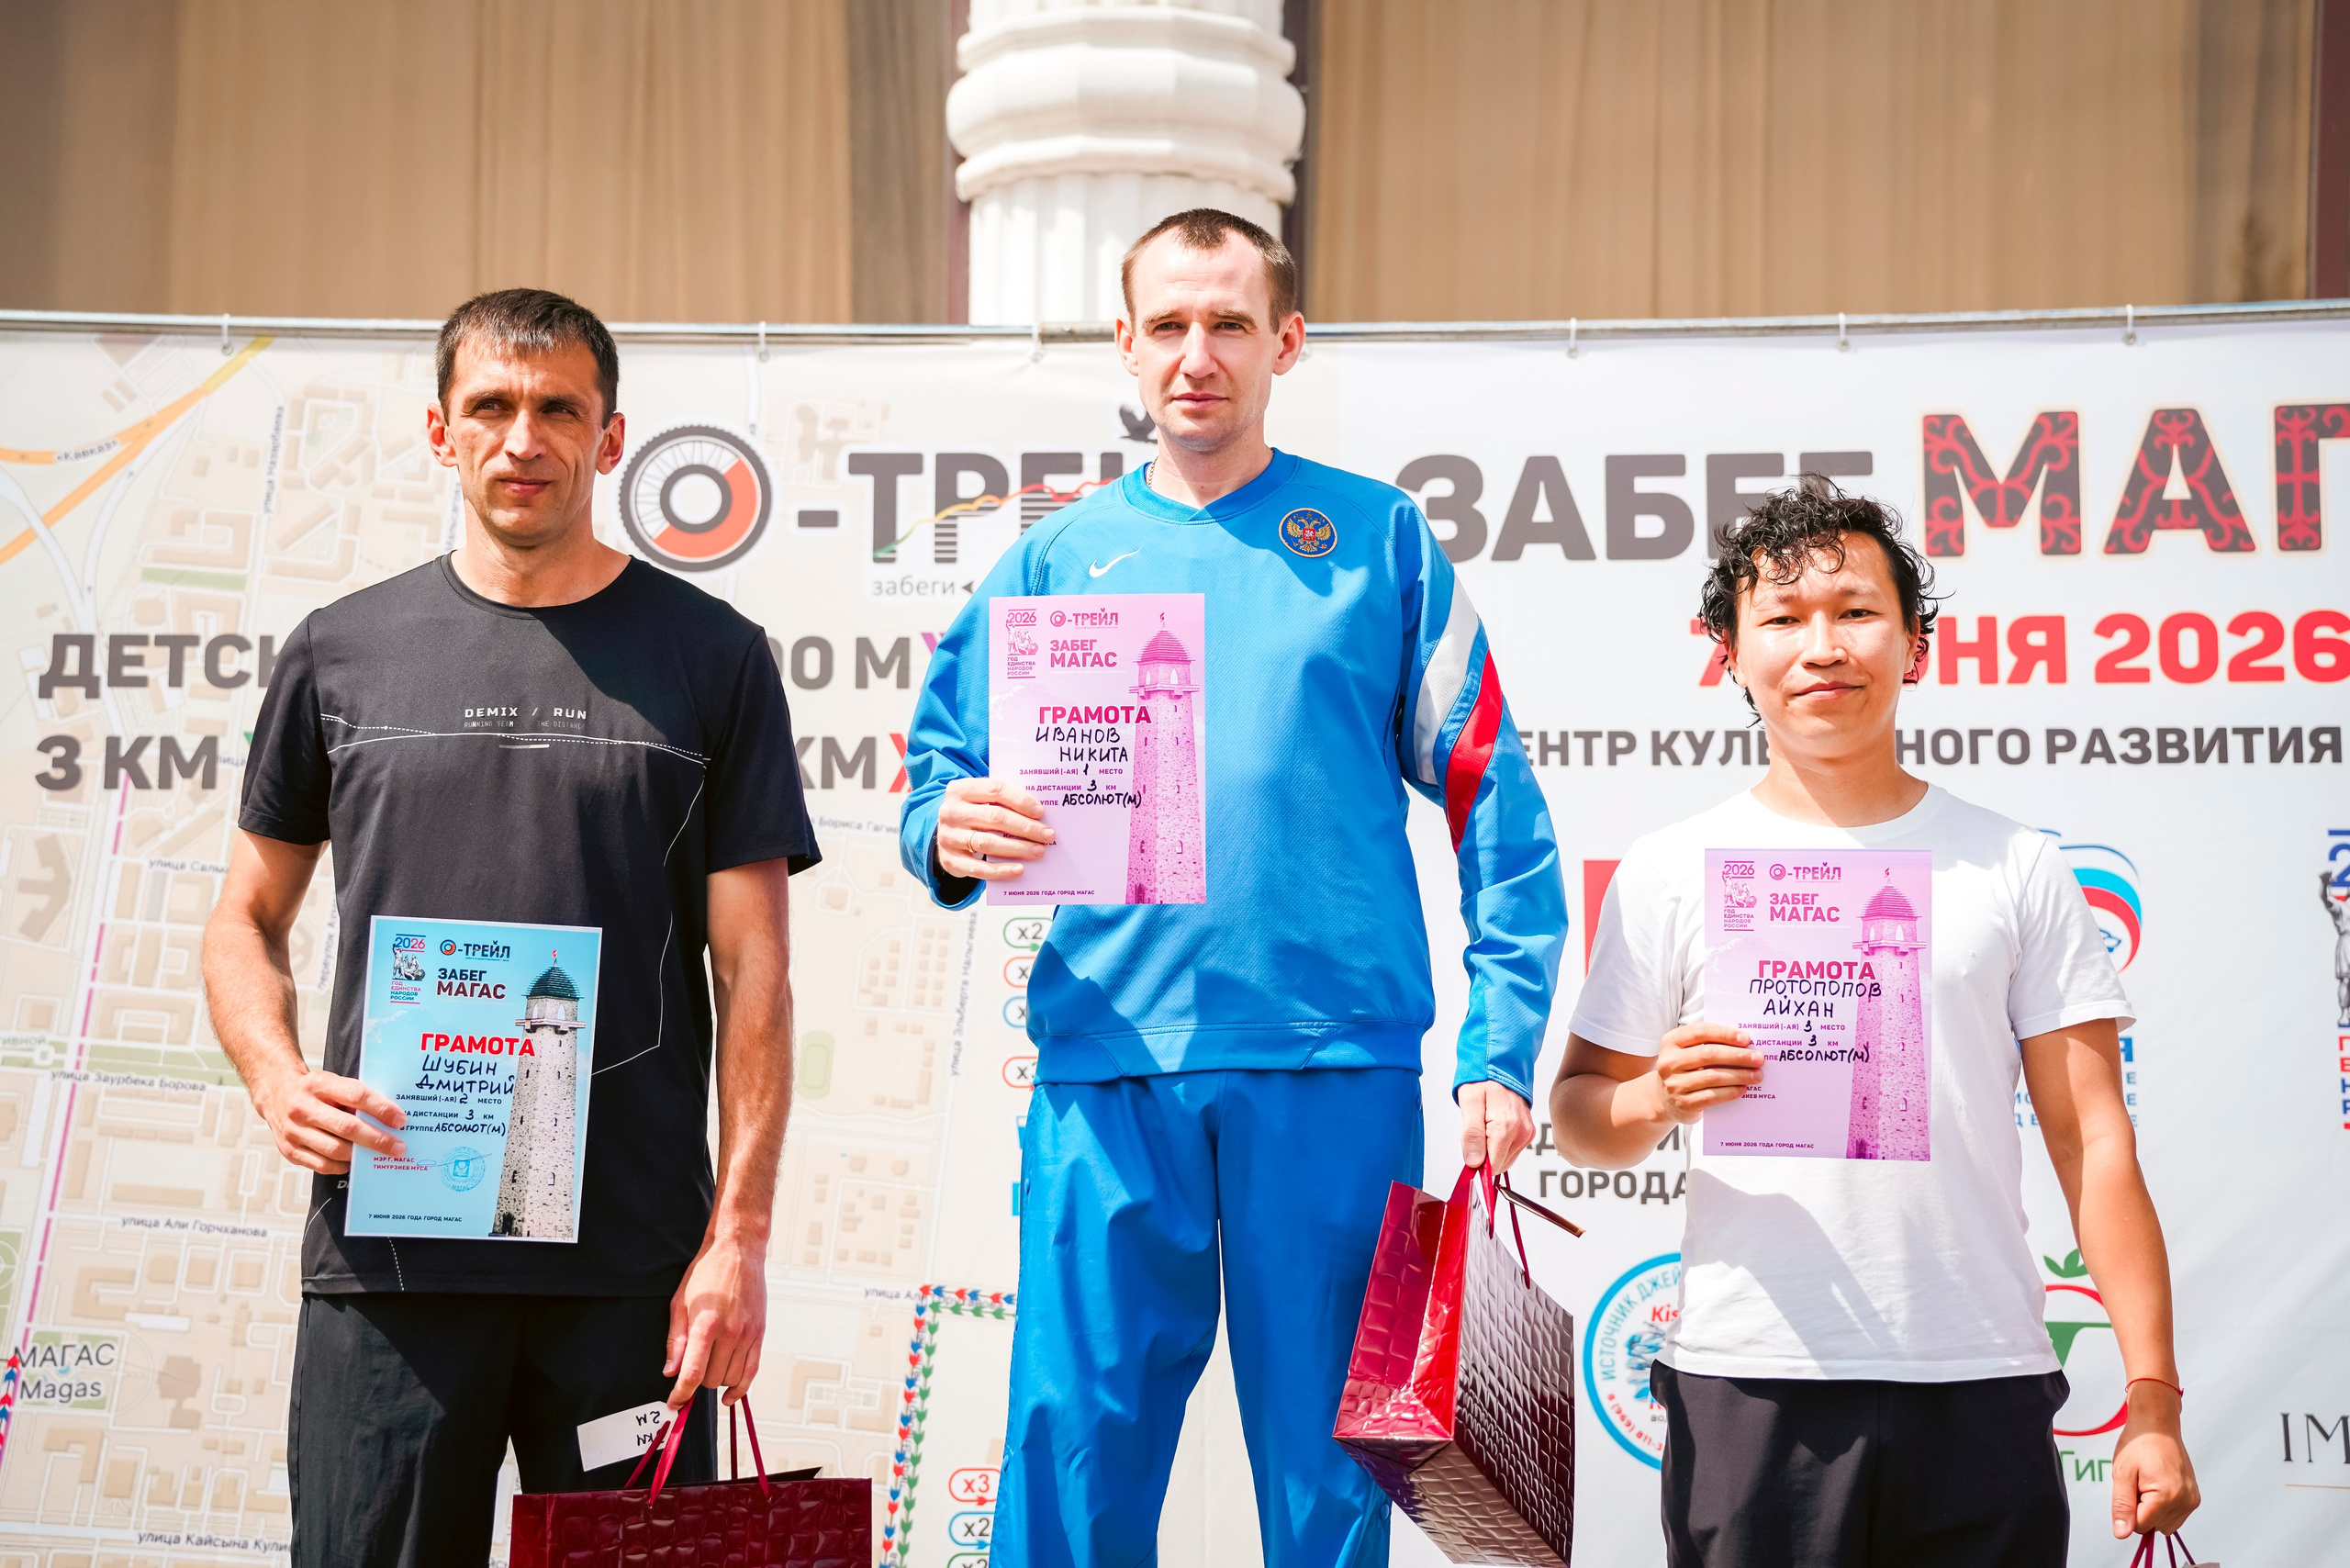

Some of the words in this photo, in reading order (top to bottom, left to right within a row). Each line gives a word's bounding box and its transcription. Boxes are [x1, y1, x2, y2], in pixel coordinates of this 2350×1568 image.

[872, 575, 955, 596] забеги
[1007, 611, 1037, 623] 2026
[1050, 639, 1097, 652] ЗАБЕГ
[2093, 610, 2350, 684] 2026
[855, 636, 911, 689] М
[1050, 652, 1117, 668] МАГАС
[464, 707, 519, 718] DEMIX
[554, 707, 588, 720] RUN
[1038, 705, 1152, 724] ГРАМОТА
[1035, 726, 1121, 745] ИВАНОВ
[1059, 745, 1128, 762] НИКИТА
[1518, 730, 1637, 767] НТР
[2045, 726, 2343, 766] РАЗВИТИЯ
[35, 734, 82, 791] 3
[104, 735, 218, 790] КМ
[1087, 778, 1097, 791] 3
[1723, 863, 1755, 876] 2026
[1769, 892, 1819, 905] ЗАБЕГ
[1770, 906, 1840, 922] МАГАС
[394, 936, 426, 950] 2026
[438, 968, 487, 982] ЗАБЕГ
[1758, 959, 1876, 980] ГРАМОТА
[436, 980, 507, 1000] МАГАС
[1749, 978, 1883, 998] ПРОТОПОПОВ
[1763, 994, 1834, 1018] АЙХАН
[420, 1033, 536, 1057] ГРАМОТА
[1808, 1034, 1817, 1047] 3
[421, 1053, 498, 1076] ШУБИН
[51, 1070, 90, 1082] улица
[95, 1073, 155, 1087] Заурбека
[160, 1078, 207, 1092] Борова
[415, 1074, 516, 1095] ДМИТРИЙ
[396, 1093, 438, 1102] ЗАНЯВШИЙ
[459, 1092, 468, 1104] 2
[412, 1110, 459, 1118] ДИСТАНЦИИ
[464, 1109, 475, 1120] 3
[120, 1216, 160, 1229] улица
[164, 1217, 189, 1230] Али
[192, 1220, 268, 1238] Горчханова
[864, 1287, 901, 1300] улица
[1598, 1294, 1639, 1382] ИСТОЧНИК
[1635, 1265, 1682, 1301] ДЖЕЙ
[13, 1343, 116, 1369] МАГАС
[20, 1380, 102, 1404] Magas
[963, 1473, 990, 1493] x3
[964, 1518, 990, 1537] x2
[138, 1532, 181, 1546] улица
[185, 1533, 249, 1549] Кайсына
